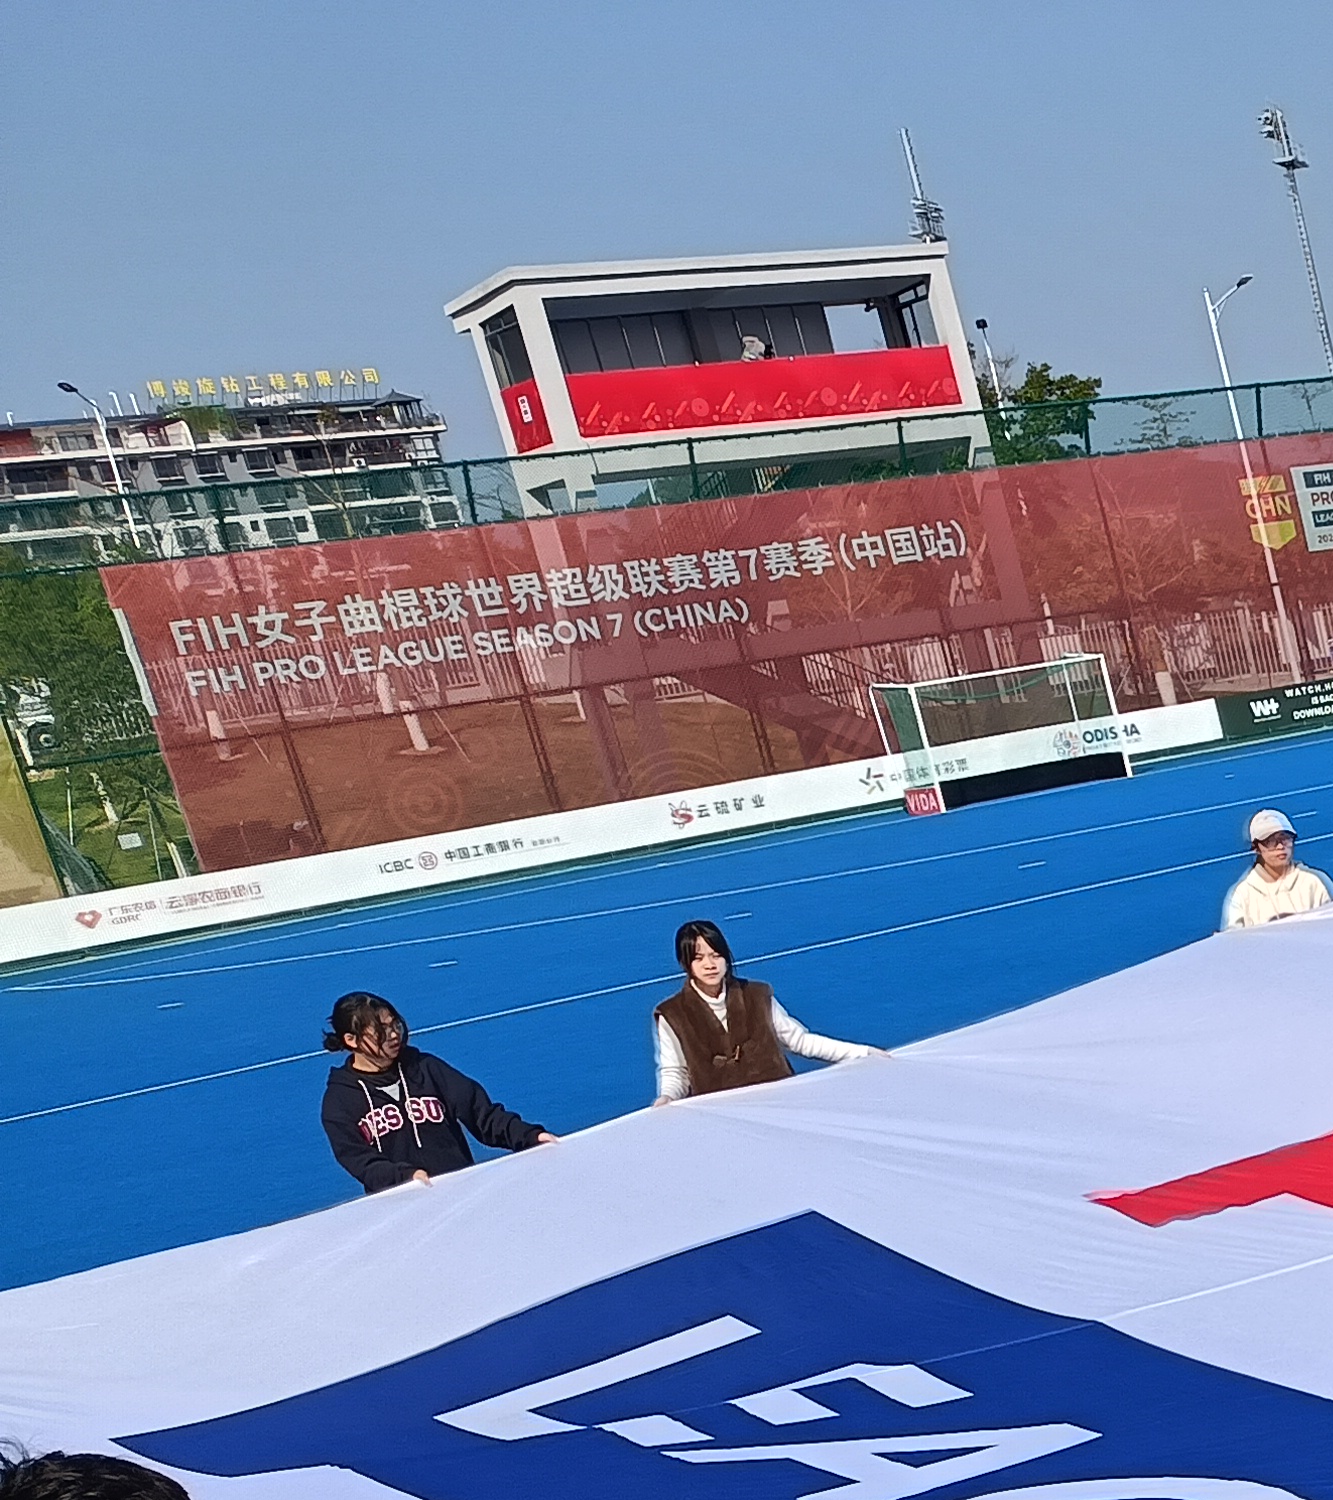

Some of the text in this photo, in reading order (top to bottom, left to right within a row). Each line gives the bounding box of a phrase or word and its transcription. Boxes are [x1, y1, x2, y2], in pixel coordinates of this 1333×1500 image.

[1313, 472, 1331, 485] FIH
[1246, 495, 1292, 519] CHN
[185, 597, 750, 697] FIH PRO LEAGUE SEASON 7 (CHINA)
[906, 792, 938, 811] VIDA
[444, 838, 524, 862] 中国工商银行
[379, 858, 414, 874] ICBC
